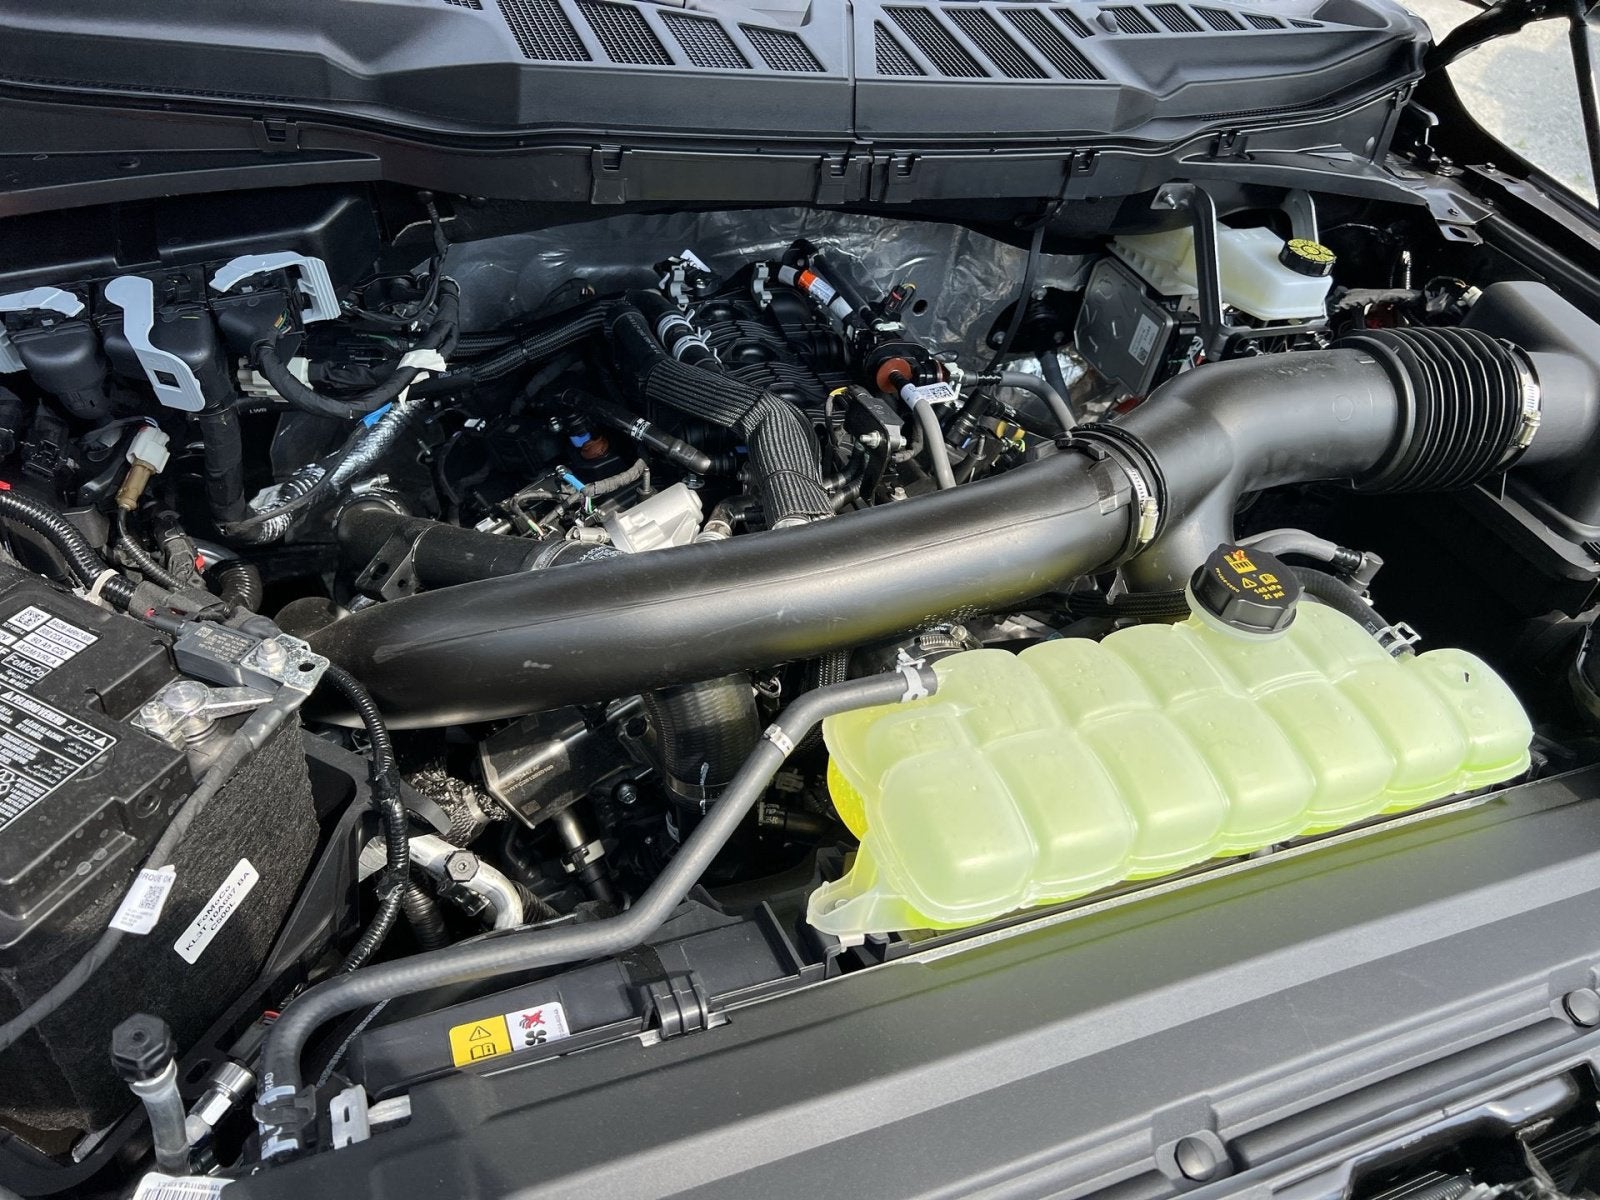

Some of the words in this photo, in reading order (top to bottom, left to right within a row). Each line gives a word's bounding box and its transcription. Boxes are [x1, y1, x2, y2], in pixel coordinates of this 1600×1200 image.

[1254, 586, 1268, 594] 145
[5, 655, 46, 676] FoMoCo
[196, 884, 231, 927] FoMoCo
